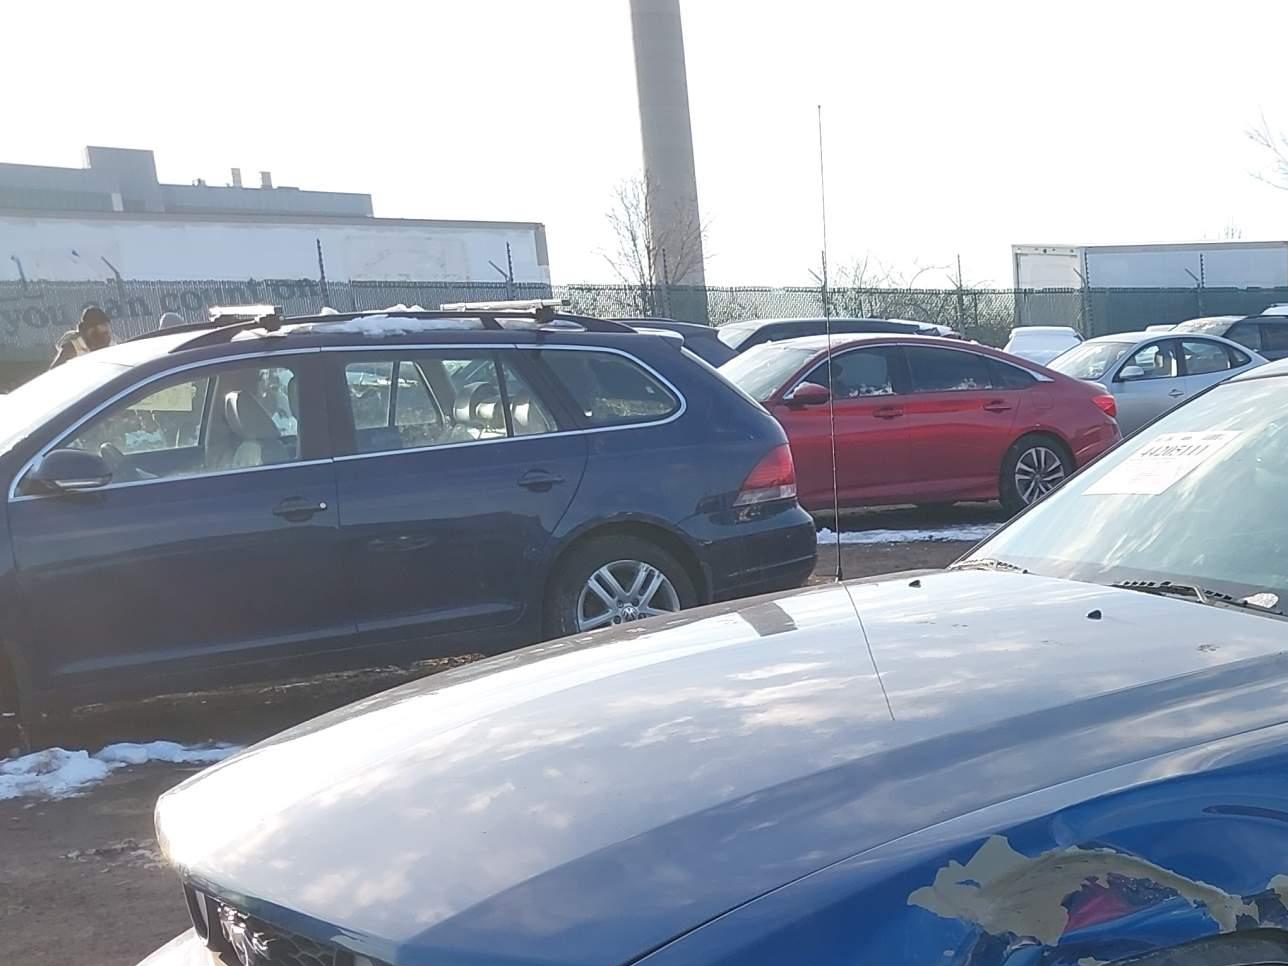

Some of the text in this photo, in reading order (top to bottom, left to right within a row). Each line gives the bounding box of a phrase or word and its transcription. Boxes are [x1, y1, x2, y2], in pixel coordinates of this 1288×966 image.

[0, 305, 74, 337] you
[82, 296, 153, 321] an
[160, 279, 266, 312] count
